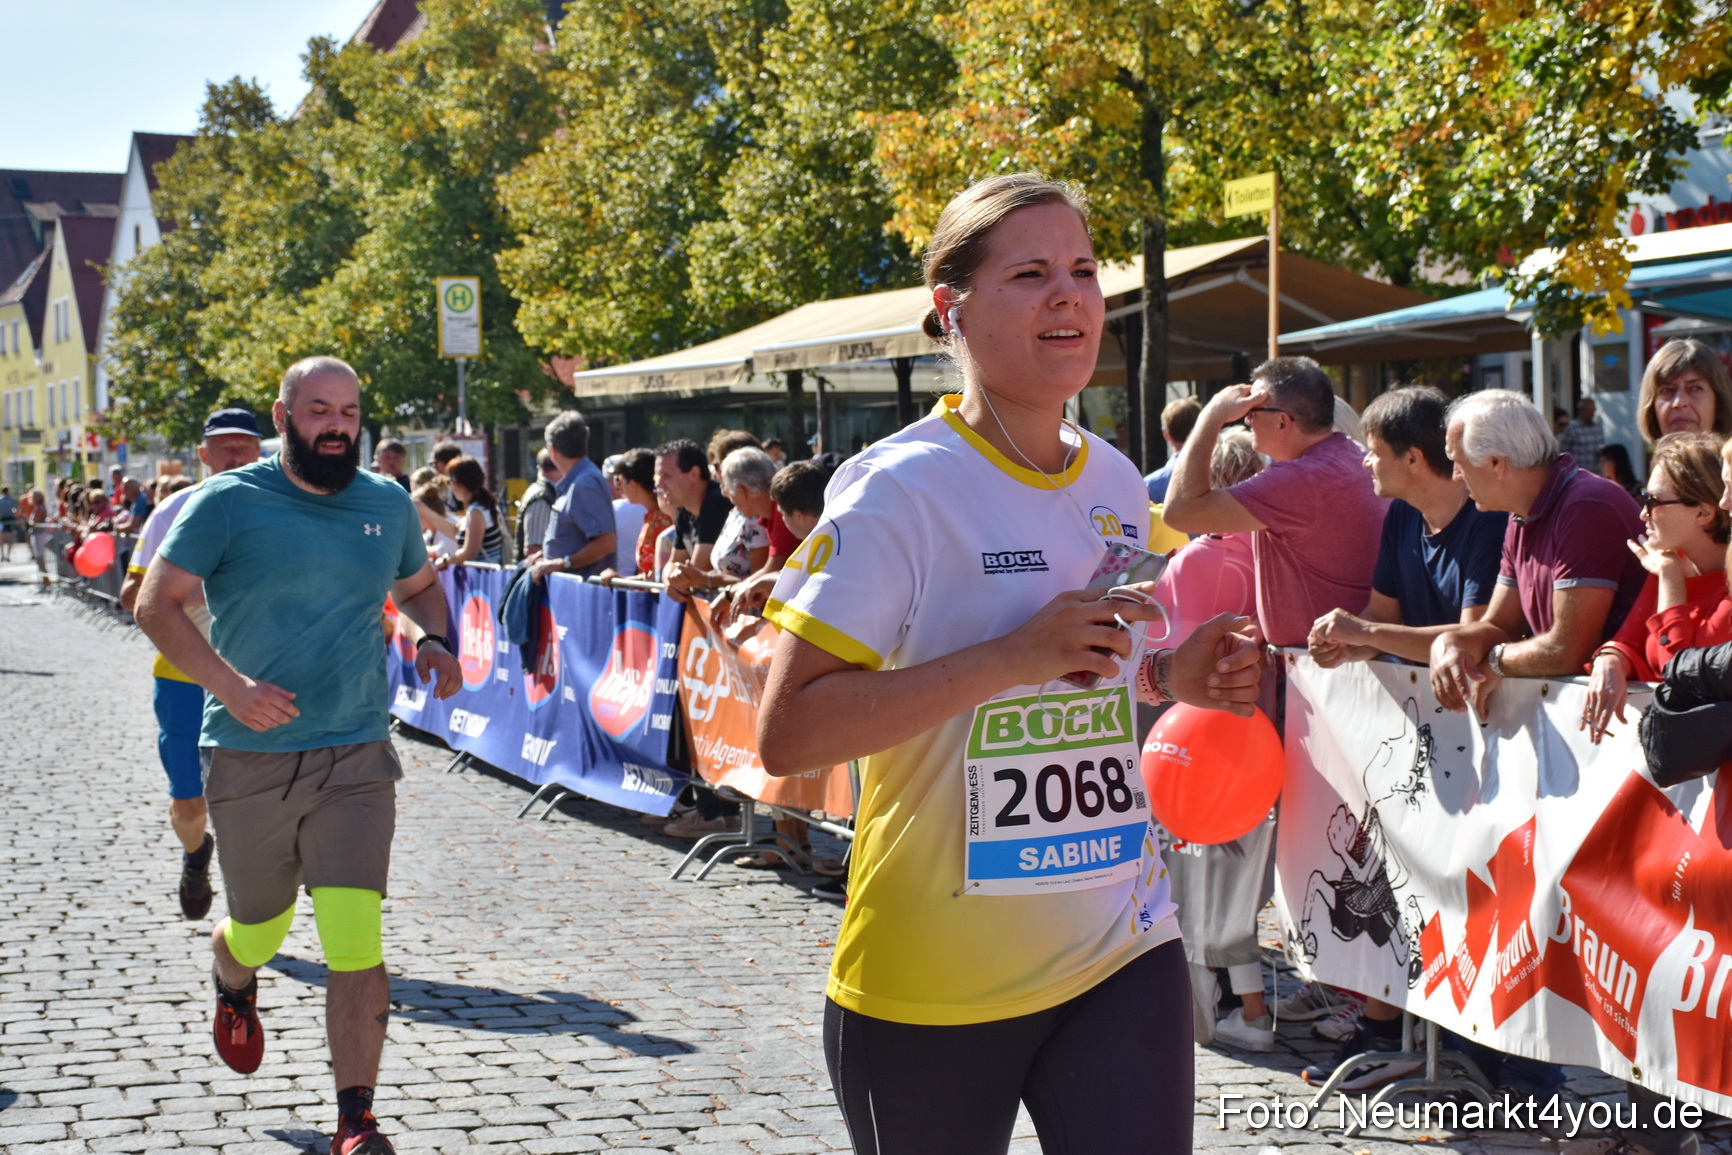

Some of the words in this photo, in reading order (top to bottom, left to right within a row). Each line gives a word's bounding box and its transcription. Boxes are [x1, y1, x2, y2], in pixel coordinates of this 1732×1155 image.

[1093, 514, 1122, 536] 20
[983, 551, 1046, 567] BOCK
[986, 697, 1118, 744] BOCK
[1127, 759, 1133, 770] D
[993, 757, 1133, 827] 2068
[1018, 835, 1122, 871] SABINE
[1675, 851, 1691, 879] 1929
[1672, 880, 1682, 901] Seit
[1549, 884, 1637, 1013] Braun
[1584, 973, 1602, 1005] Sicher
[1603, 998, 1613, 1015] ist
